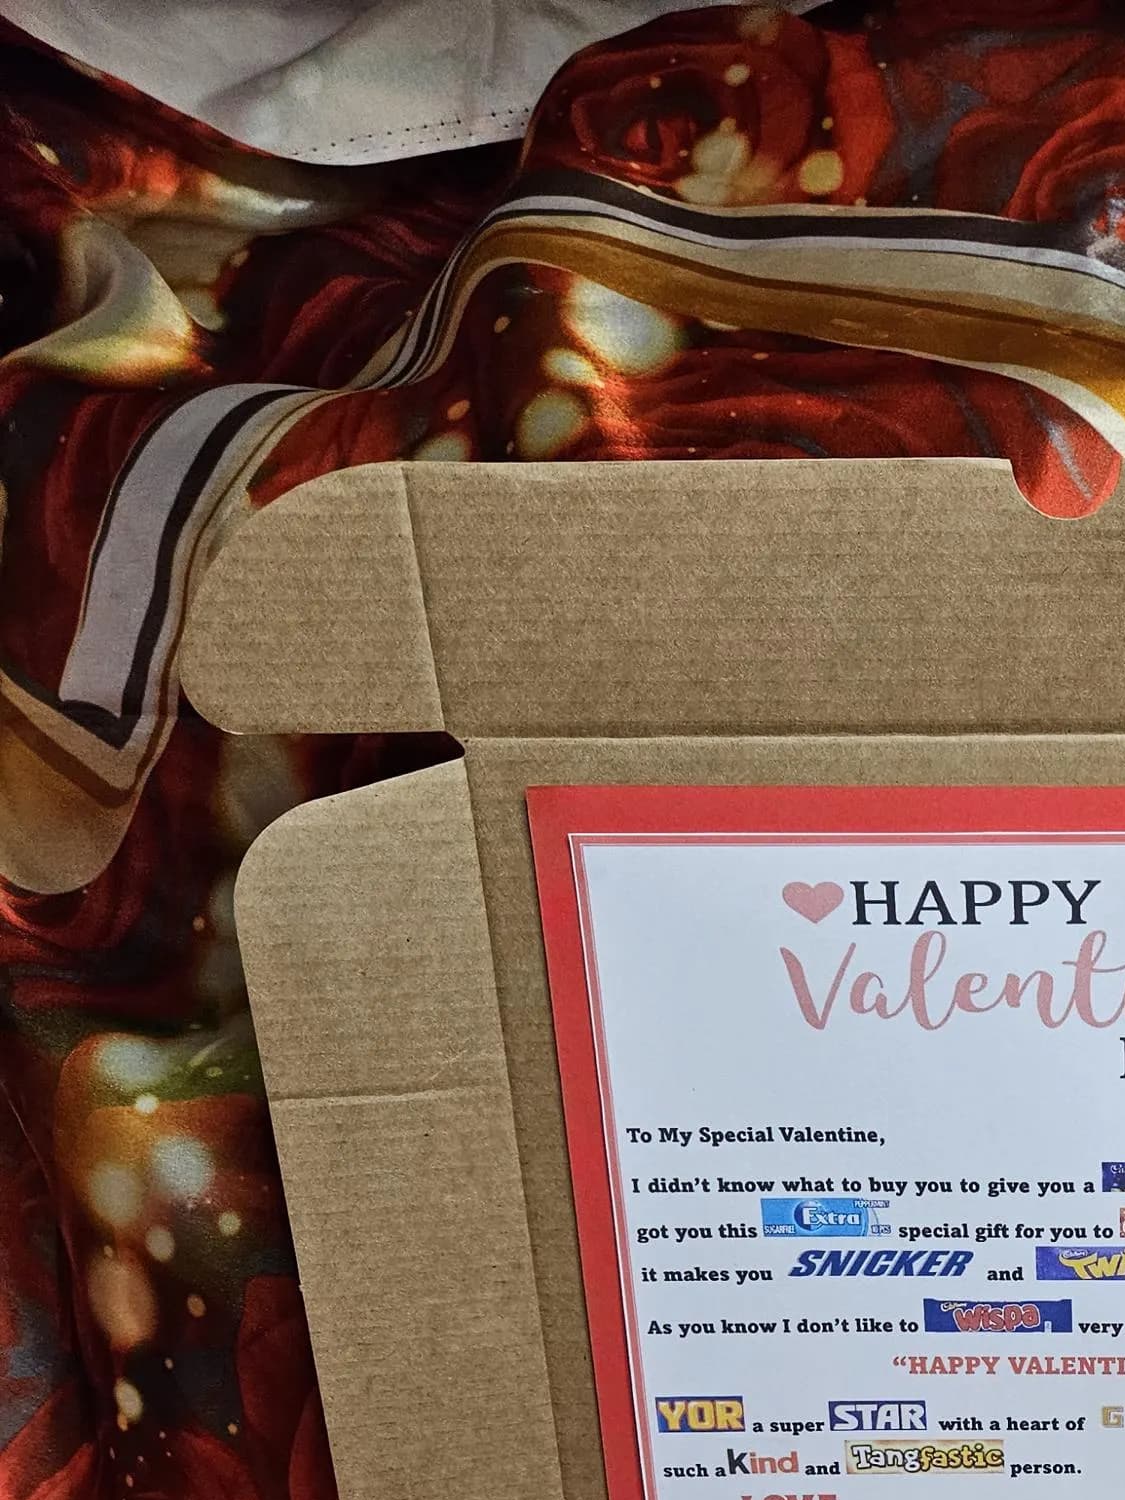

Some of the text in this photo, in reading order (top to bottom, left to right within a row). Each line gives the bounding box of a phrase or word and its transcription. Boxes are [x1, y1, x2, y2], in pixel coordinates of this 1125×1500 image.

[850, 880, 1101, 925] HAPPY
[625, 1126, 885, 1148] To My Special Valentine,
[631, 1178, 641, 1194] I
[647, 1177, 711, 1194] didn’t
[716, 1177, 776, 1193] know
[781, 1176, 835, 1193] what
[841, 1177, 862, 1193] to
[867, 1176, 908, 1197] buy
[914, 1181, 953, 1197] you
[959, 1178, 980, 1194] to
[987, 1177, 1030, 1198] give
[1036, 1181, 1076, 1198] you
[1083, 1181, 1096, 1194] a
[636, 1224, 670, 1244] got
[674, 1227, 713, 1244] you
[717, 1222, 758, 1239] this
[803, 1207, 860, 1225] Extra
[898, 1222, 970, 1242] special
[974, 1223, 1010, 1243] gift
[1014, 1223, 1045, 1239] for
[1049, 1227, 1088, 1243] you
[1092, 1224, 1114, 1239] to
[641, 1267, 658, 1282] it
[662, 1266, 730, 1282] makes
[735, 1269, 774, 1286] you
[787, 1250, 975, 1278] SNICKER
[986, 1266, 1025, 1282] and
[647, 1320, 673, 1335] As
[677, 1323, 716, 1339] you
[720, 1319, 777, 1334] know
[782, 1318, 791, 1334] I
[796, 1317, 850, 1334] don’t
[854, 1317, 894, 1333] like
[898, 1318, 919, 1333] to
[1077, 1322, 1124, 1338] very
[658, 1401, 744, 1430] YOR
[752, 1421, 764, 1433] a
[769, 1421, 825, 1436] super
[834, 1404, 926, 1430] STAR
[938, 1416, 984, 1431] with
[989, 1420, 1001, 1431] a
[1006, 1416, 1060, 1431] heart
[1065, 1416, 1086, 1431] of
[663, 1445, 1082, 1478] such a Kind and Tangfastic person.
